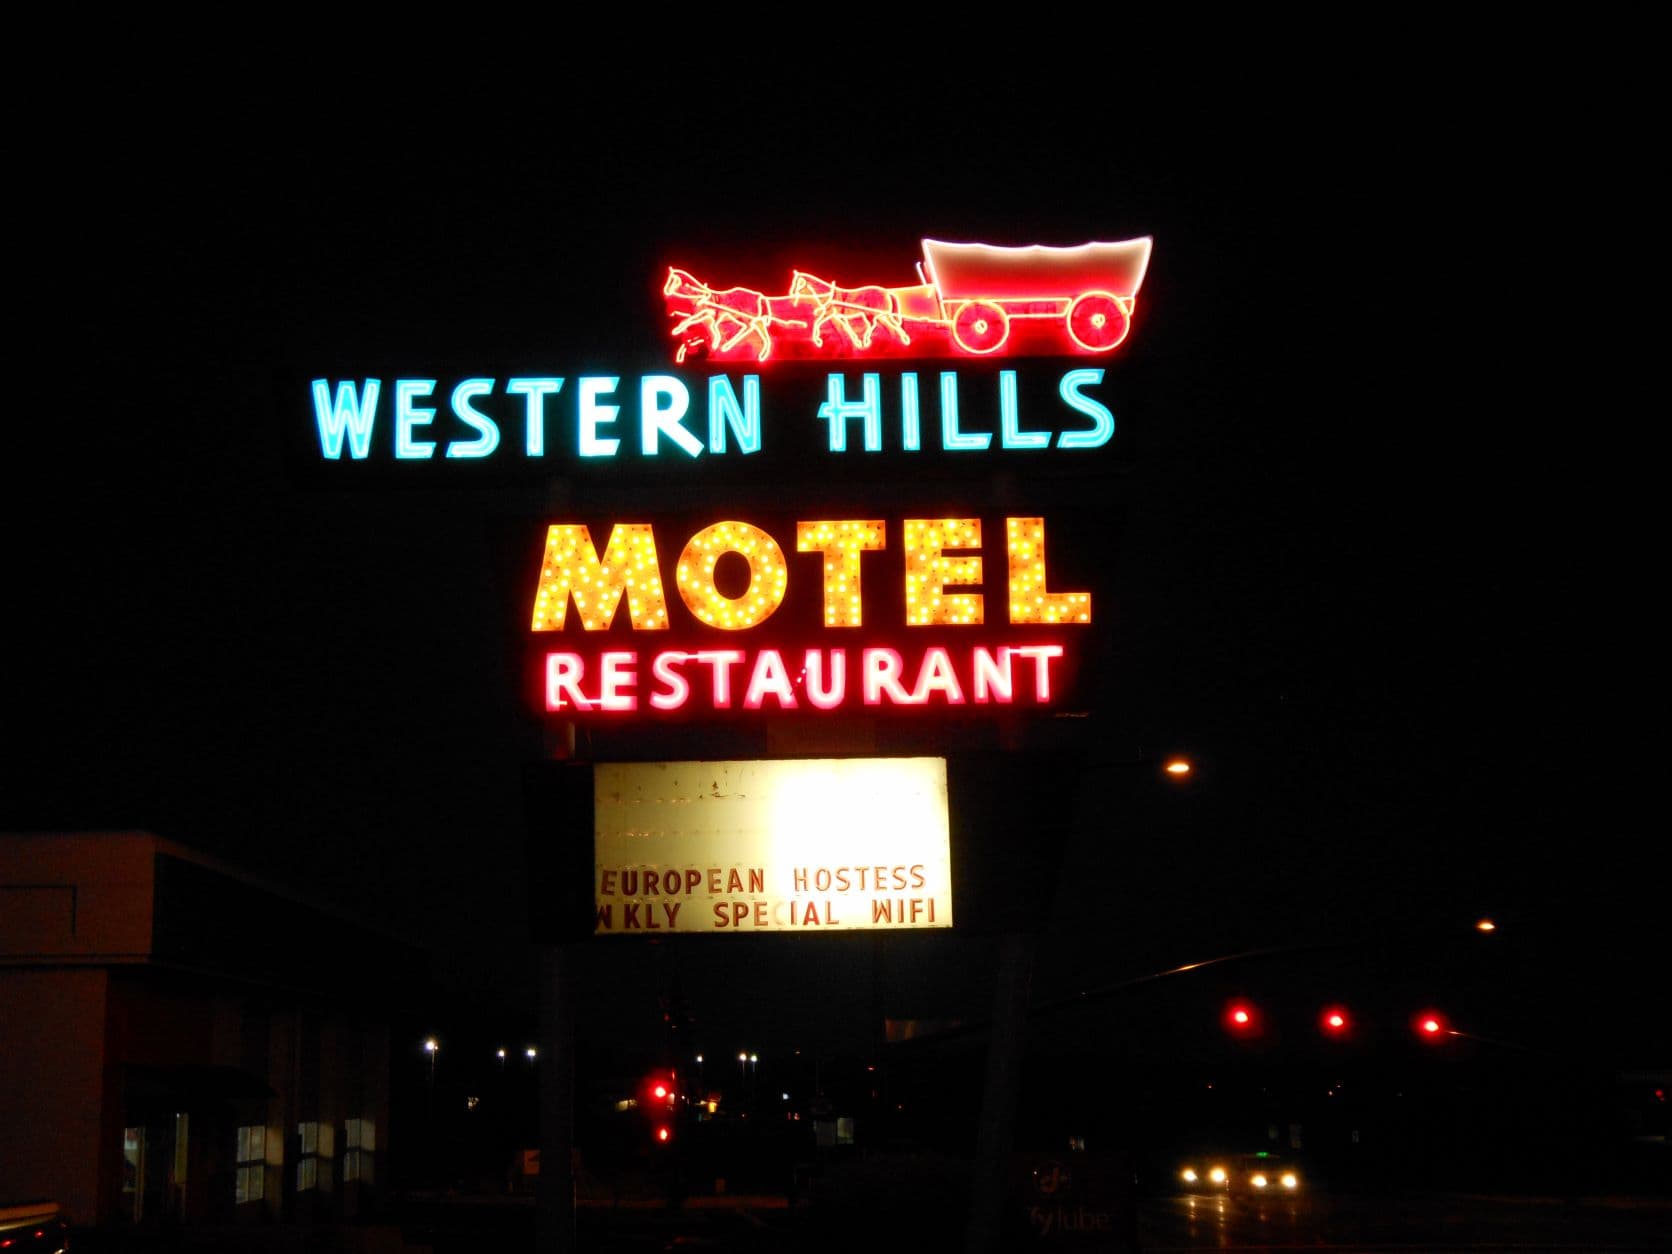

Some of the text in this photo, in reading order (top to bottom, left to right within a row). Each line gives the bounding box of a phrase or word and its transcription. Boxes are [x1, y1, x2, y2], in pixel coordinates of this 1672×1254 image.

[311, 367, 1116, 461] WESTERN HILLS
[531, 516, 1092, 632] MOTEL
[545, 645, 1065, 712] RESTAURANT
[600, 864, 925, 896] EUROPEAN HOSTESS
[712, 900, 840, 928] SPECIAL
[871, 897, 935, 924] WIFI
